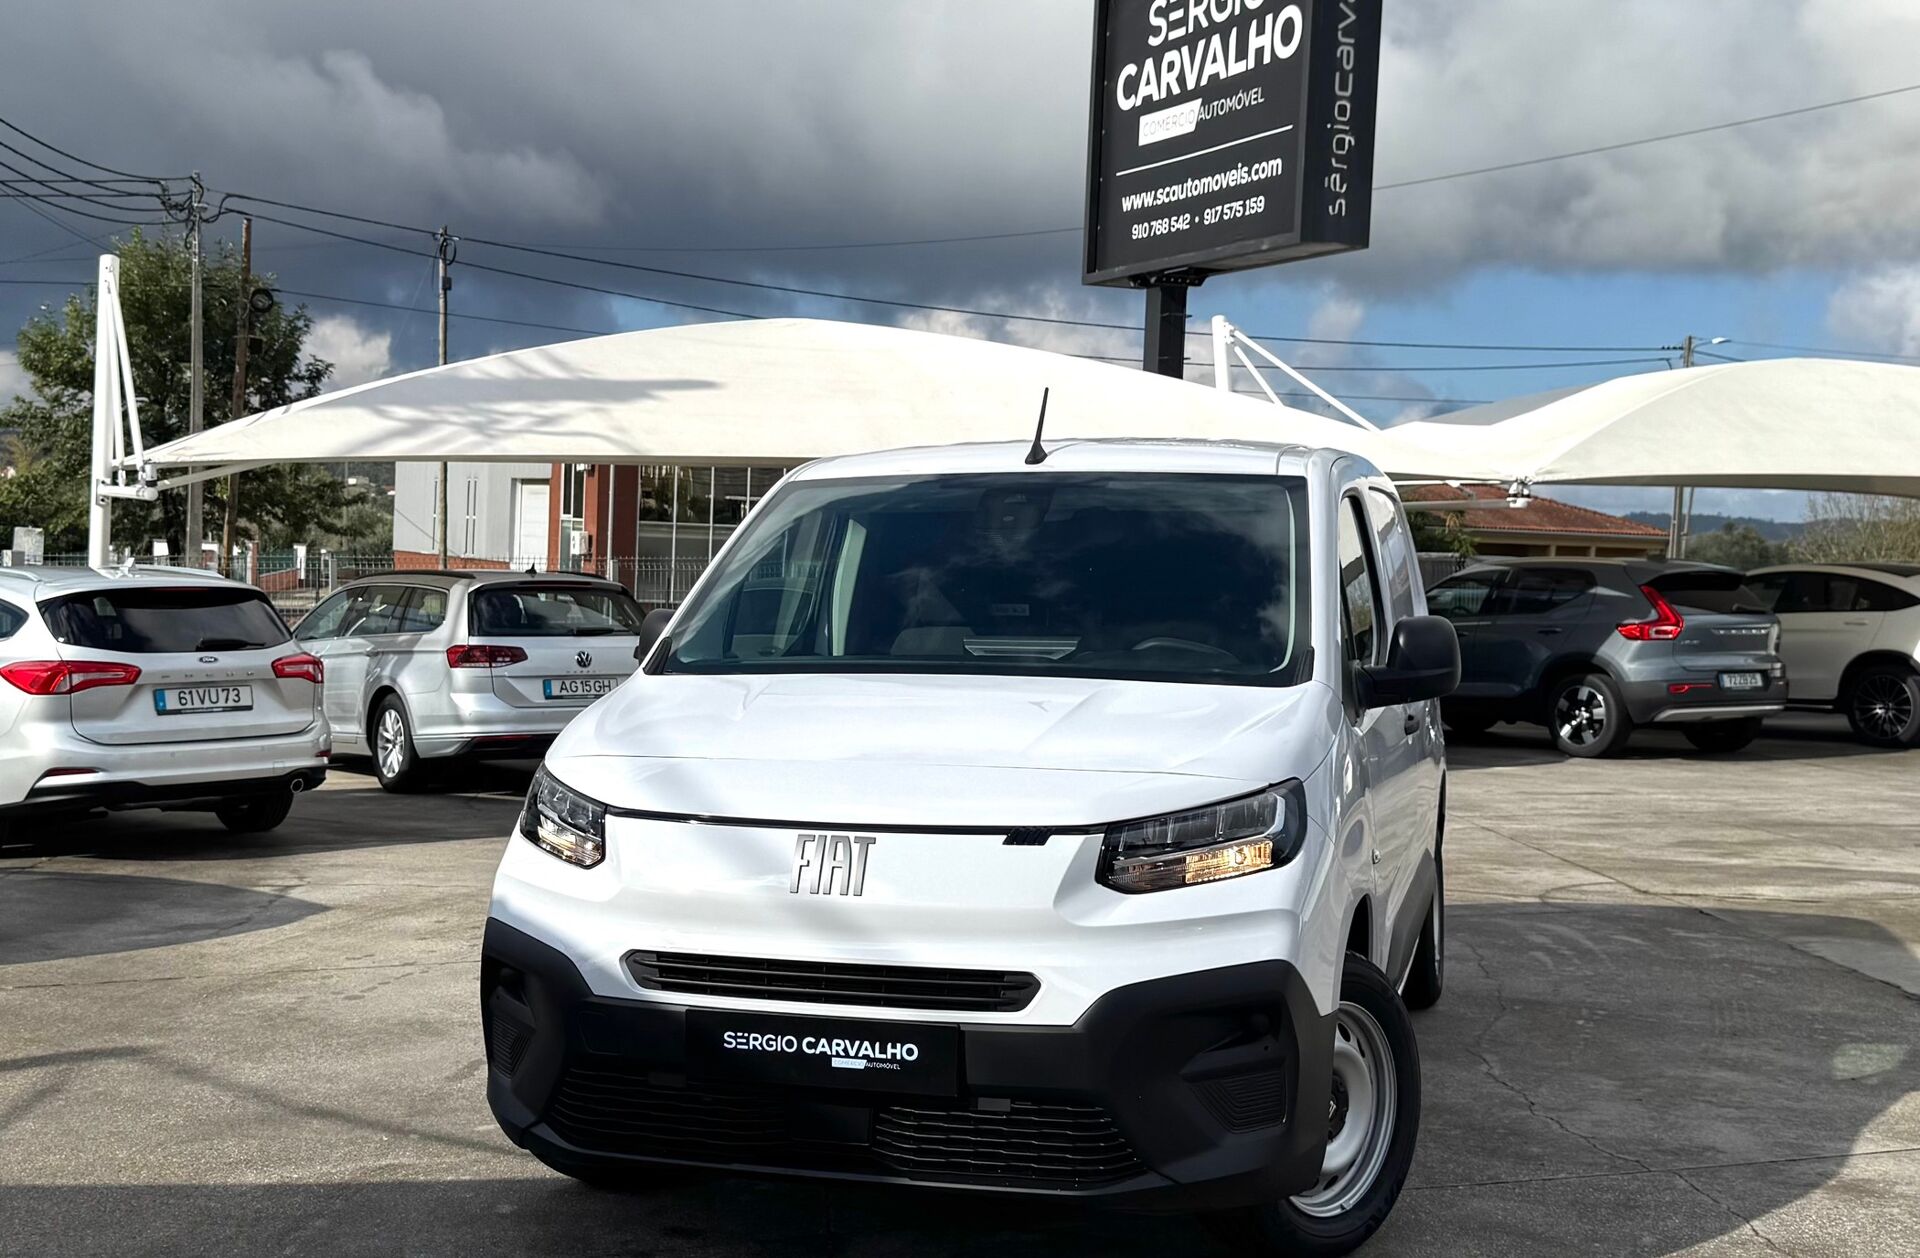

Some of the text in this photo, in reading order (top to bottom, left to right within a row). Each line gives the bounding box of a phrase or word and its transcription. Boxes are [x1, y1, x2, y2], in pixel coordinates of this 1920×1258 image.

[1116, 4, 1303, 111] CARVALHO
[1198, 86, 1265, 122] AUTOMÓVEL
[1121, 157, 1283, 212] www.scautomoveis.com
[1131, 195, 1265, 239] 910 768 542 917 575 159
[178, 688, 241, 706] 61VU73
[789, 834, 877, 897] FIAT
[802, 1036, 919, 1061] CARVALHO
